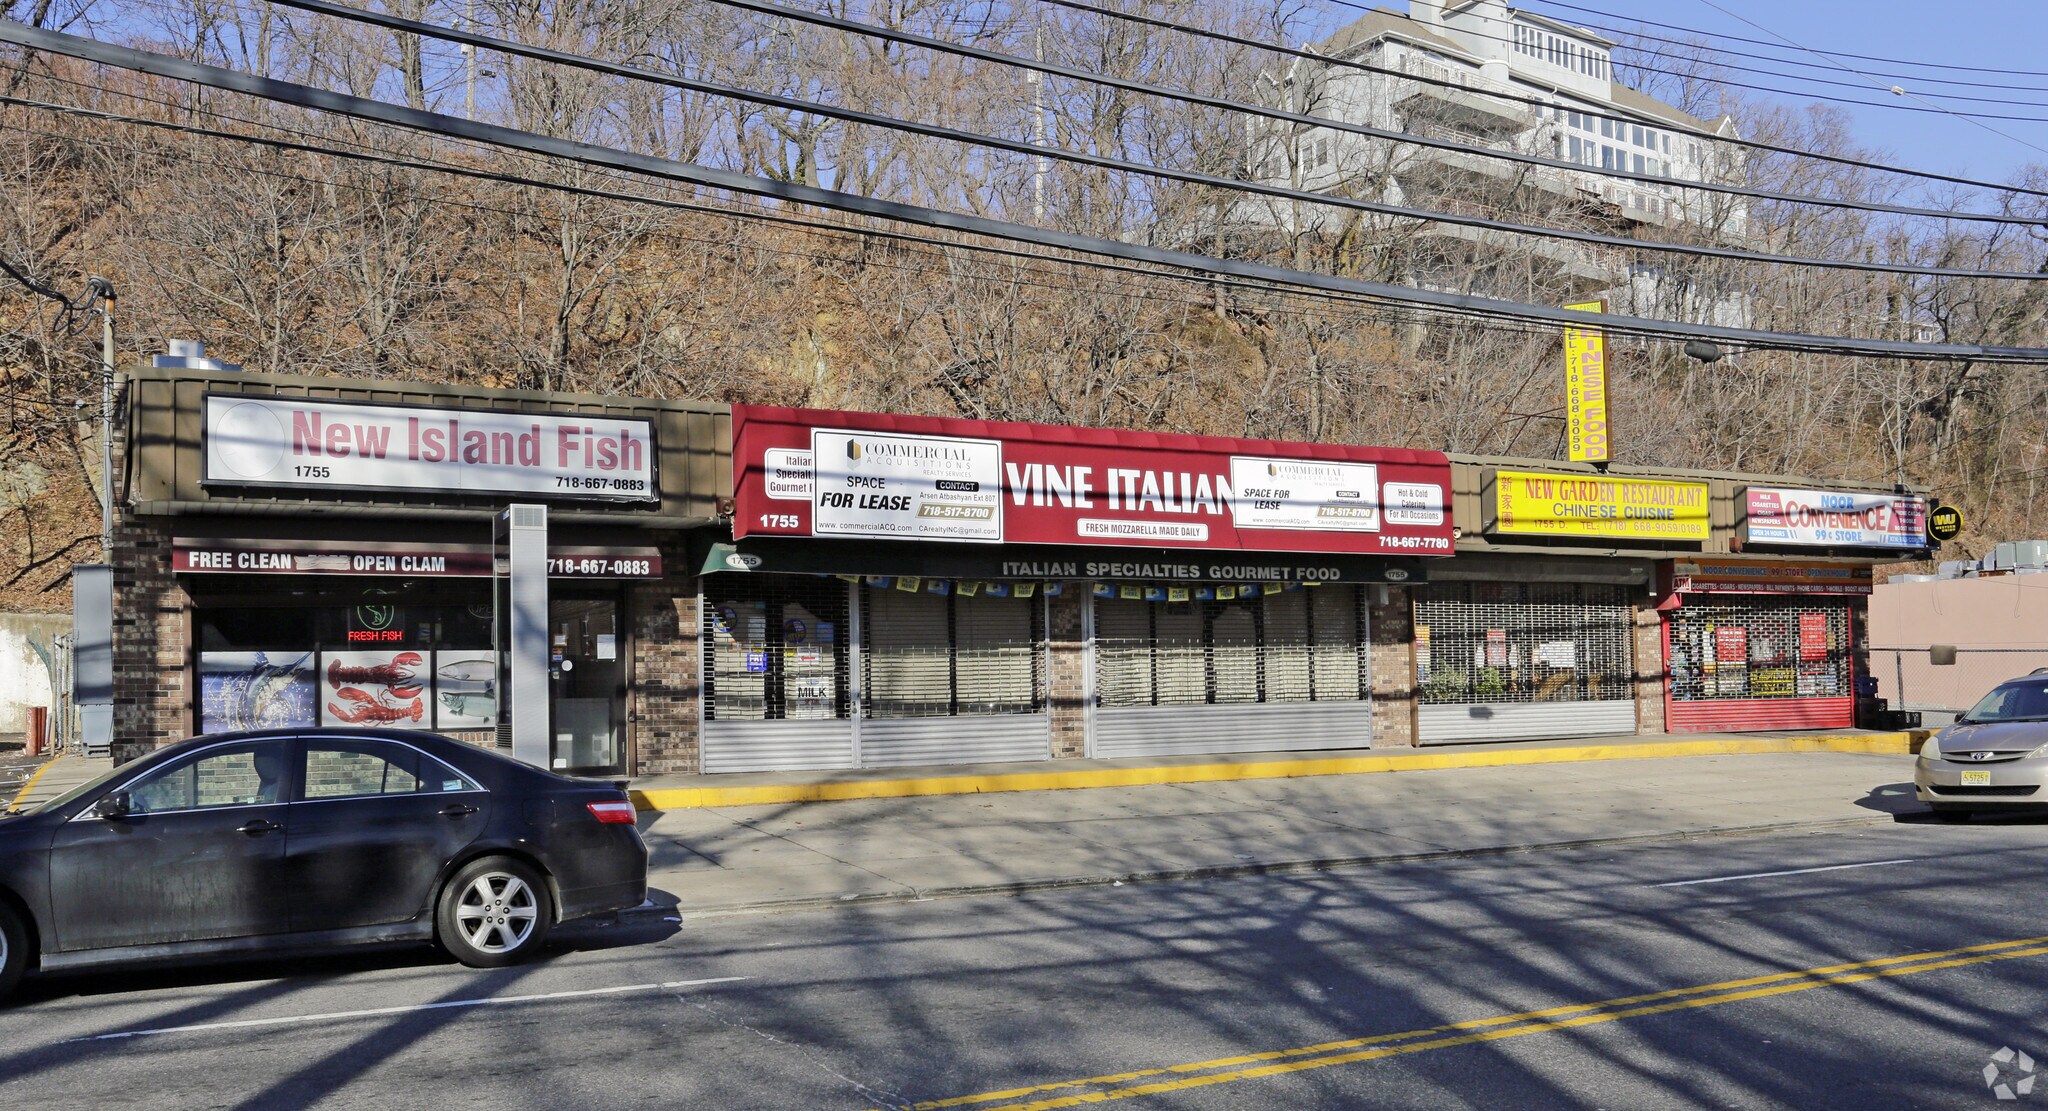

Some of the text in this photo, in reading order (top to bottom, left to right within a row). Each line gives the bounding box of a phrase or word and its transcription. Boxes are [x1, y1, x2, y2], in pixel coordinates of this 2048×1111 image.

[1584, 408, 1607, 459] FOOD
[292, 410, 643, 471] New Island Fish
[865, 442, 972, 462] COMMERCIAL
[866, 456, 972, 470] ACQUISITIONS
[294, 464, 330, 479] 1755
[922, 469, 972, 478] REALTY SERVICES
[1278, 464, 1345, 477] COMMERCIAL
[555, 475, 645, 491] 718-667-0883
[770, 481, 807, 493] Gourmet
[846, 475, 886, 490] SPACE
[939, 481, 976, 491] CONTACT
[1005, 462, 1235, 515] VINE ITALIAN
[919, 491, 938, 500] Arsen
[973, 494, 984, 502] Ext
[985, 494, 996, 503] 807
[1243, 488, 1290, 499] SPACE FOR
[1337, 490, 1359, 498] CONTACT
[1397, 488, 1428, 498] Hot & Cold
[1525, 477, 1703, 507] NEW GARDEN RESTAURANT
[819, 491, 912, 511] FOR LEASE
[1254, 500, 1281, 510] LEASE
[1401, 499, 1427, 510] Catering
[1751, 501, 1780, 509] CIGARETTES
[1820, 494, 1855, 510] NOOR
[923, 505, 990, 519] 718-517-8700
[1321, 506, 1371, 518] 718-517-8700
[1389, 509, 1439, 521] For All Occasions
[1553, 502, 1675, 521] CHINESE CUISNE
[1785, 499, 1887, 531] CONVENIENCE
[760, 514, 799, 528] 1755
[1534, 519, 1555, 529] 1755
[1580, 520, 1599, 530] TEL:
[1603, 519, 1627, 531] (718)
[1751, 517, 1781, 525] NEWSPAPERS
[1085, 522, 1201, 537] FRESH MOZZARELLA MADE DAILY
[1815, 529, 1827, 540] 99
[1835, 530, 1863, 542] STORE
[1378, 535, 1449, 549] 718-667-7780
[188, 551, 446, 573] FREE CLEAN OPEN CLAM
[547, 558, 650, 576] 718-667-0883
[731, 556, 757, 566] 1755
[1002, 561, 1341, 581] ITALIAN SPECIALTIES GOURMET FOOD
[1387, 571, 1406, 579] 1755
[1785, 568, 1804, 577] STORE
[1673, 578, 1690, 590] ATM
[1691, 582, 1717, 590] CIGARETTES
[1737, 583, 1764, 591] NEWSPAPERS
[348, 630, 403, 642] FRESH FISH
[797, 686, 827, 698] MILK
